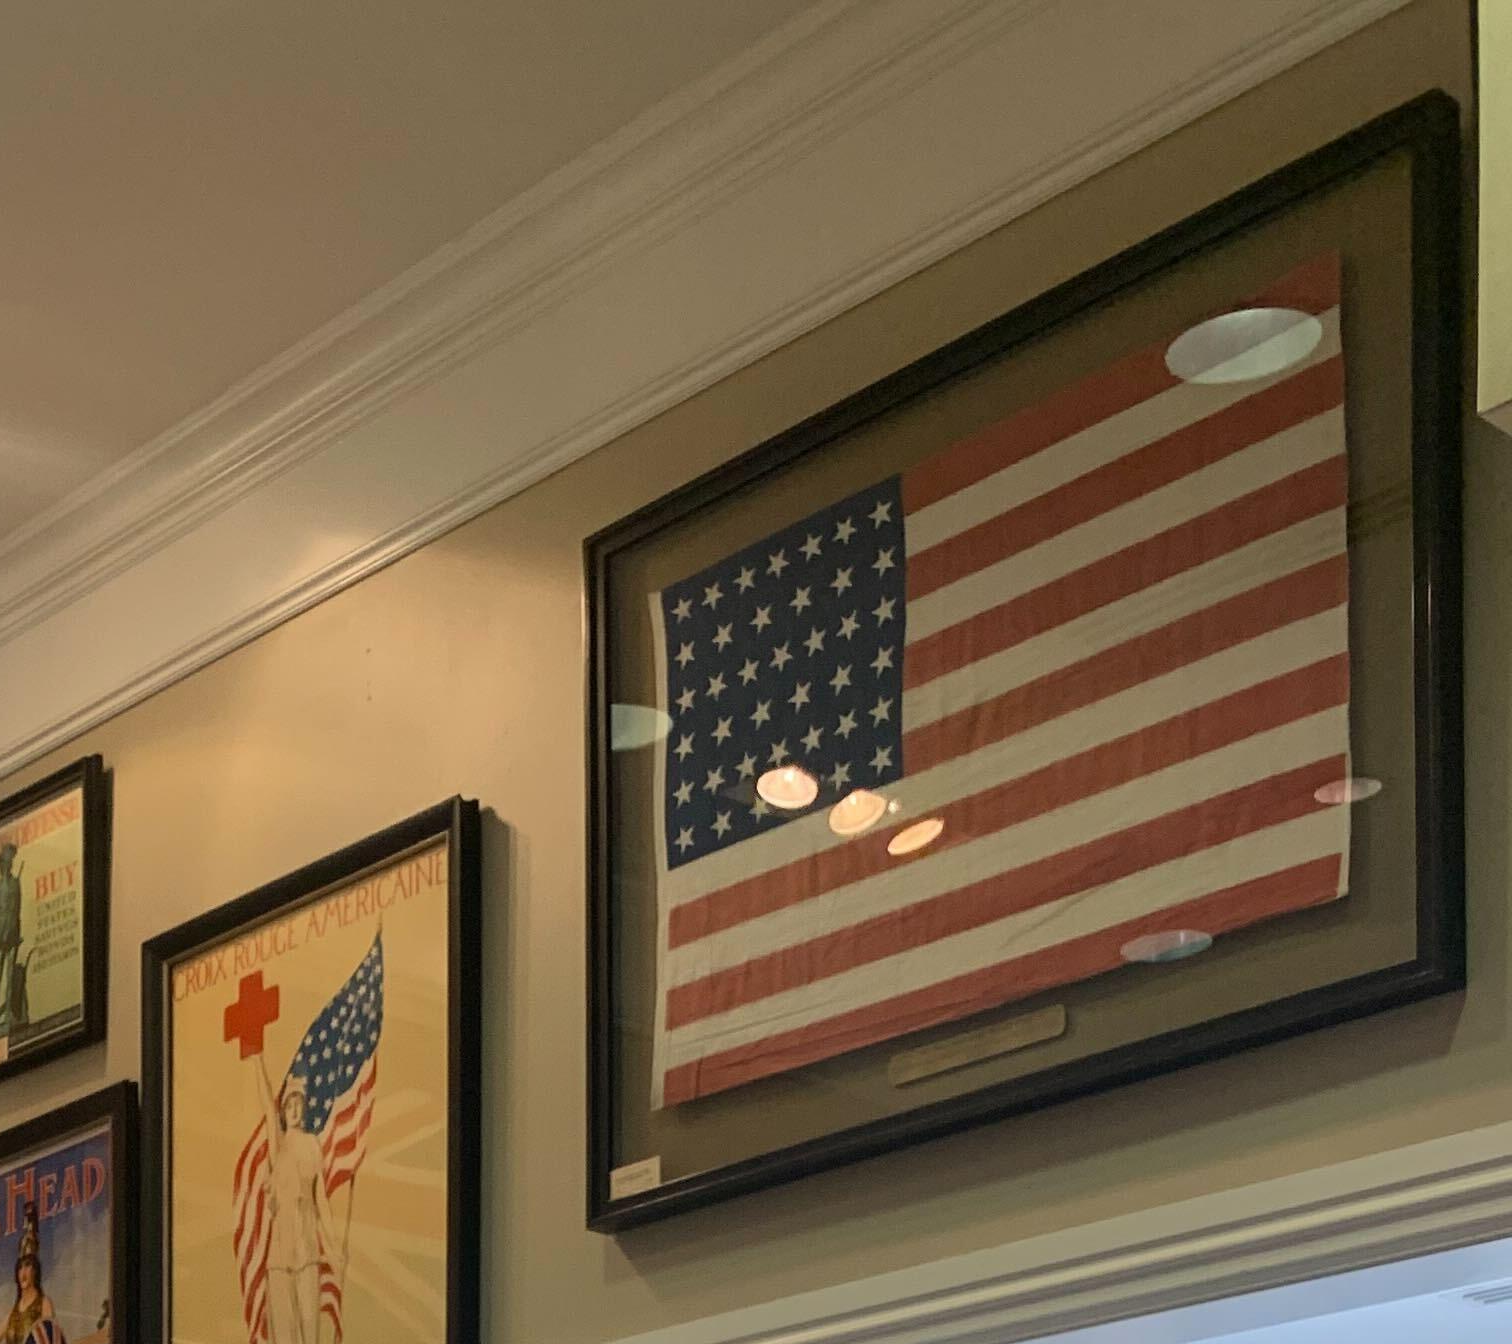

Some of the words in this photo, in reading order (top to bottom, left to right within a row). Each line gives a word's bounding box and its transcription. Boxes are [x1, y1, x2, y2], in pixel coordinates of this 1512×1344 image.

[34, 860, 79, 901] BUY
[173, 951, 227, 1002] CROIX
[305, 851, 446, 944] AMERICAINE
[4, 1156, 105, 1236] HEAD
